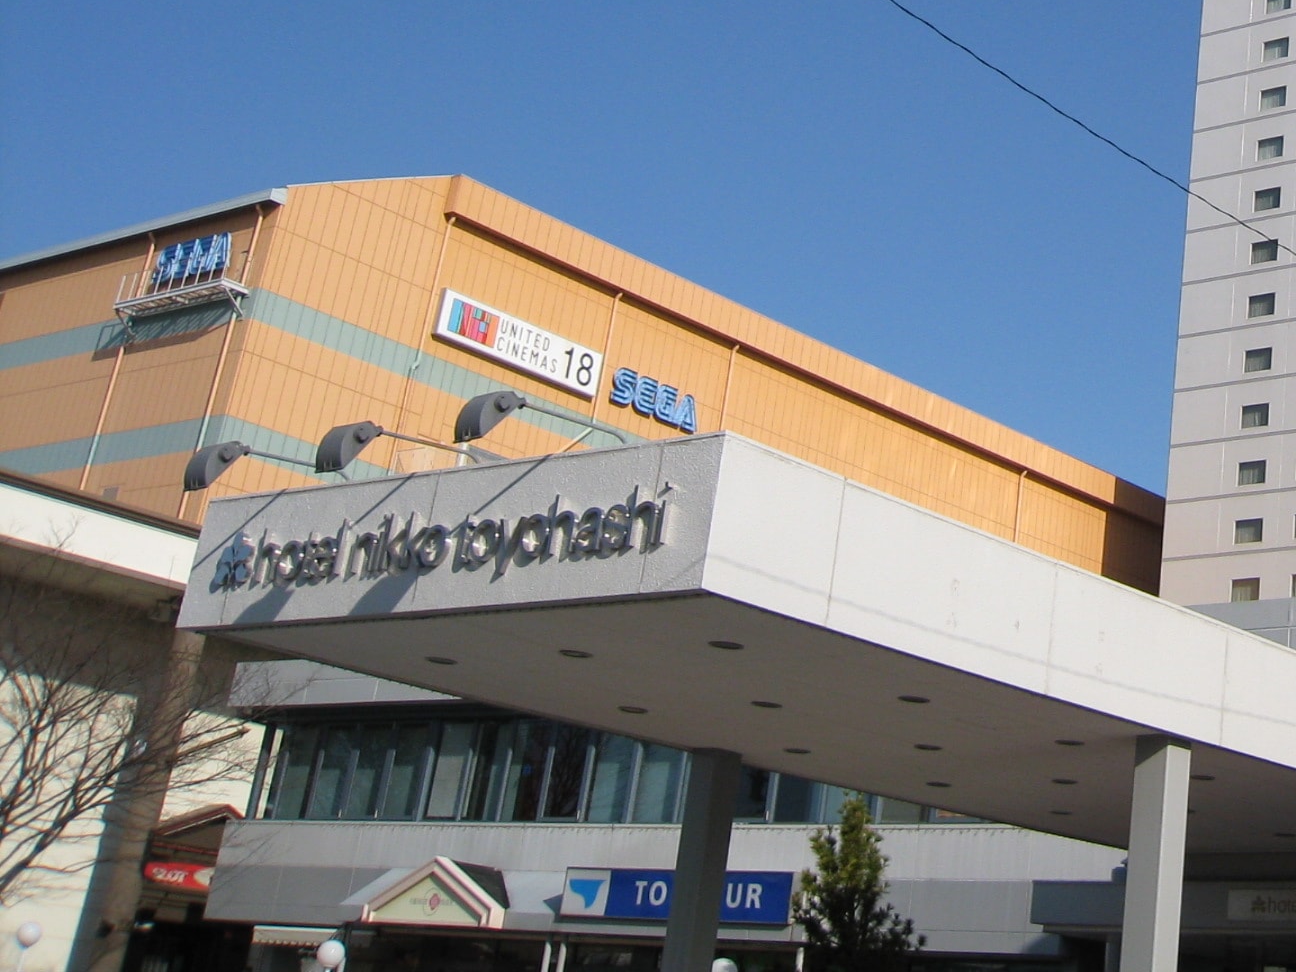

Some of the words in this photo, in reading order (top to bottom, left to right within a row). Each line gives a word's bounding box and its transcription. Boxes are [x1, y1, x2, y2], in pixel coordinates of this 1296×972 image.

[152, 232, 231, 283] SEGA
[496, 336, 558, 374] CINEMAS
[500, 318, 551, 352] UNITED
[564, 346, 595, 387] 18
[610, 367, 697, 434] SEGA
[256, 518, 351, 584] hotel
[351, 511, 451, 576] nikko
[460, 481, 676, 576] toyohashi
[635, 880, 668, 907] TO
[725, 882, 763, 910] UR
